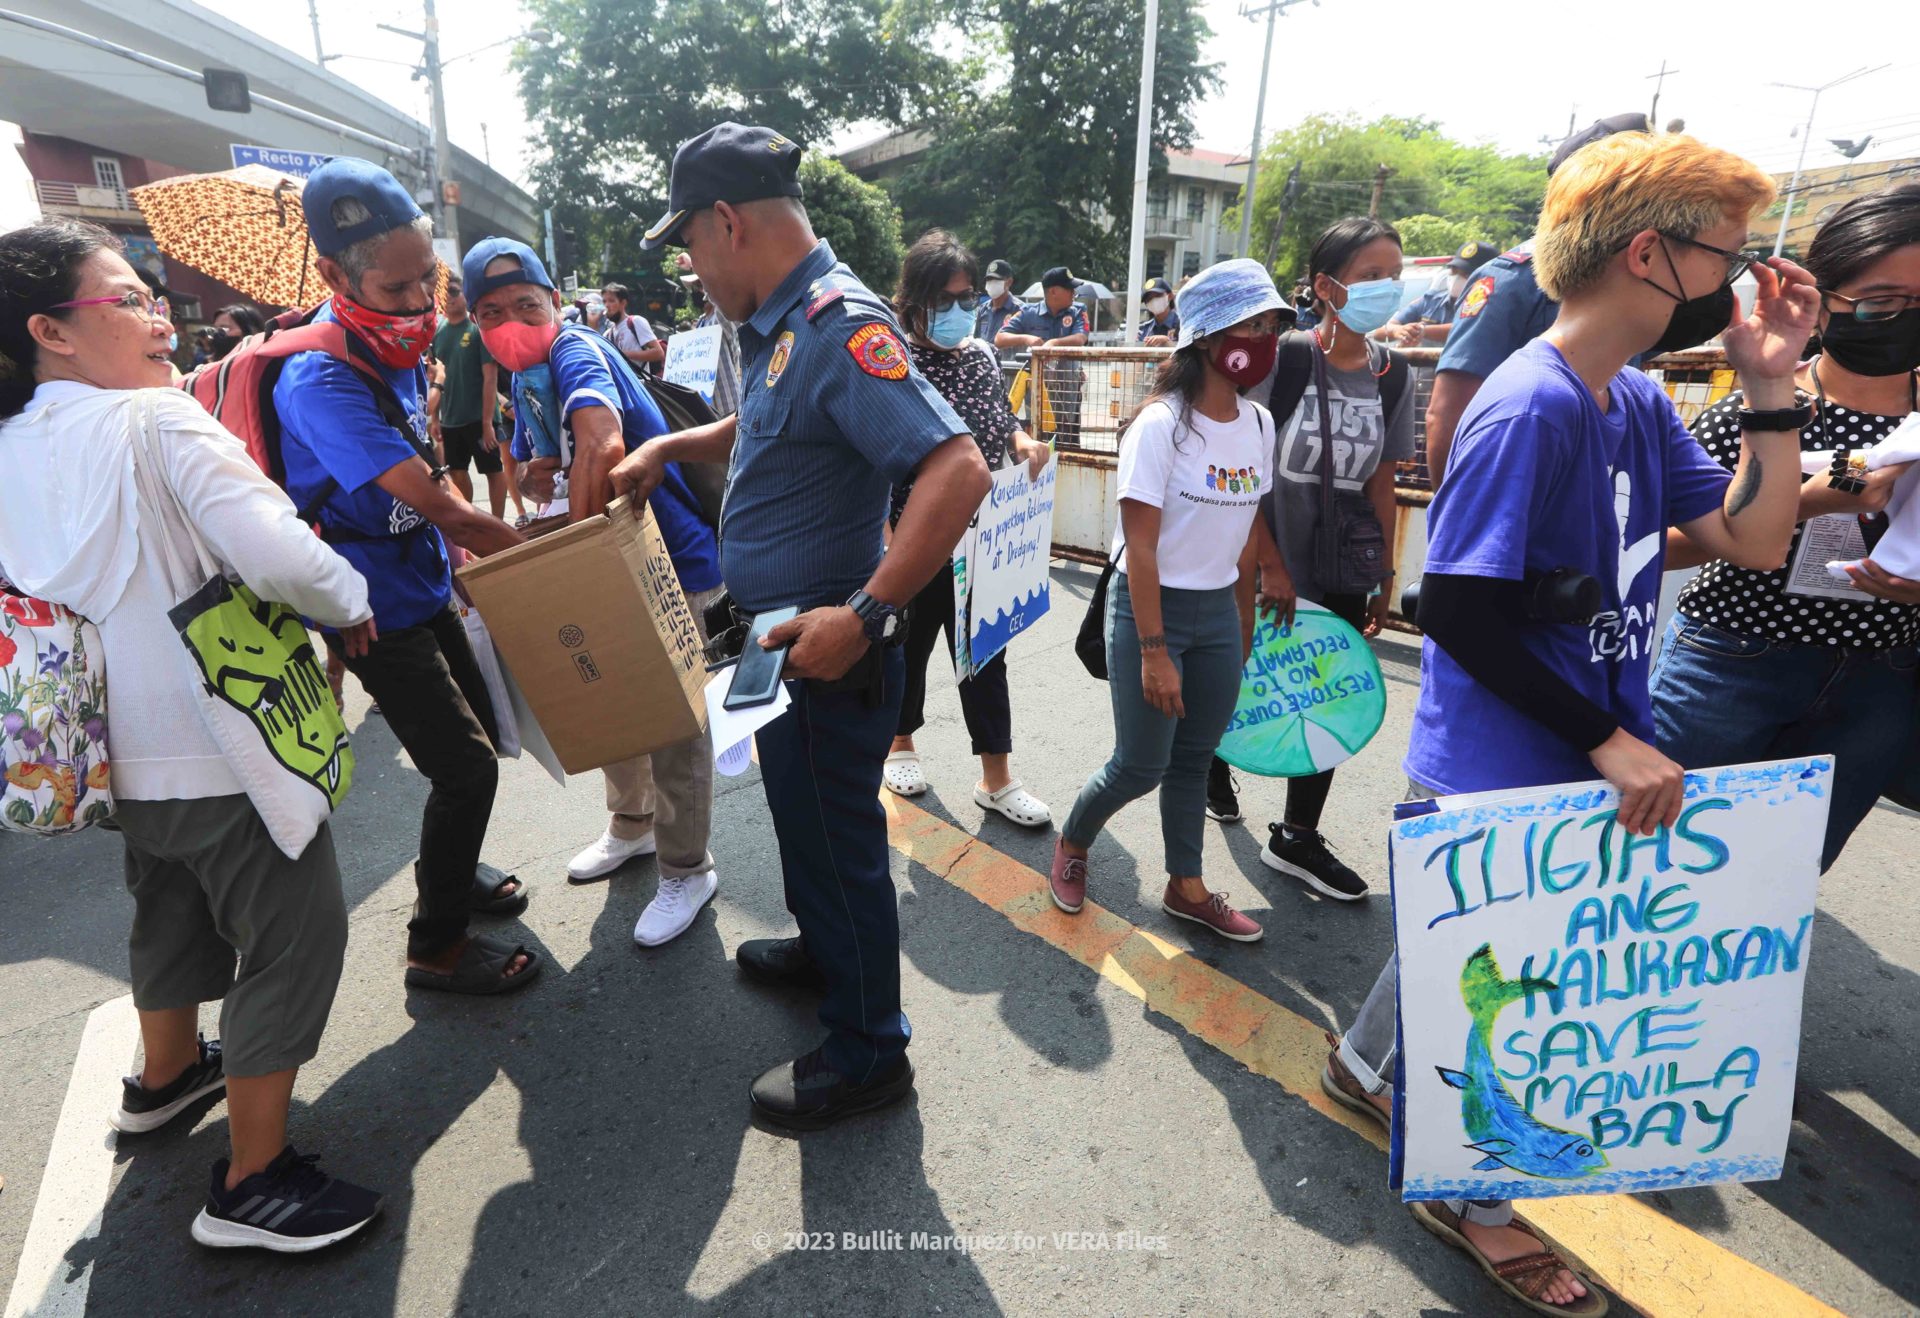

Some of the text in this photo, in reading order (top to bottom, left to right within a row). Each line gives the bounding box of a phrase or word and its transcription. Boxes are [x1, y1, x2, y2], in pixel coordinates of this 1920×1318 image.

[259, 149, 303, 166] Recto
[1301, 398, 1382, 440] JUST
[1303, 435, 1375, 478] TRY
[1179, 490, 1219, 506] Magkaisa
[980, 529, 992, 556] ng
[992, 547, 1004, 570] at
[655, 556, 697, 657] SPRING
[1009, 612, 1024, 633] CEC
[1252, 661, 1320, 697] NO TO
[1289, 671, 1376, 712] RESTORE
[1424, 798, 1731, 930] ILIGTAS
[1565, 875, 1699, 946] ANG
[1522, 914, 1814, 1020] KALIKASAN
[1500, 998, 1706, 1081] SAVE
[1524, 1046, 1760, 1119] MANILA
[1590, 1093, 1748, 1153] BAY
